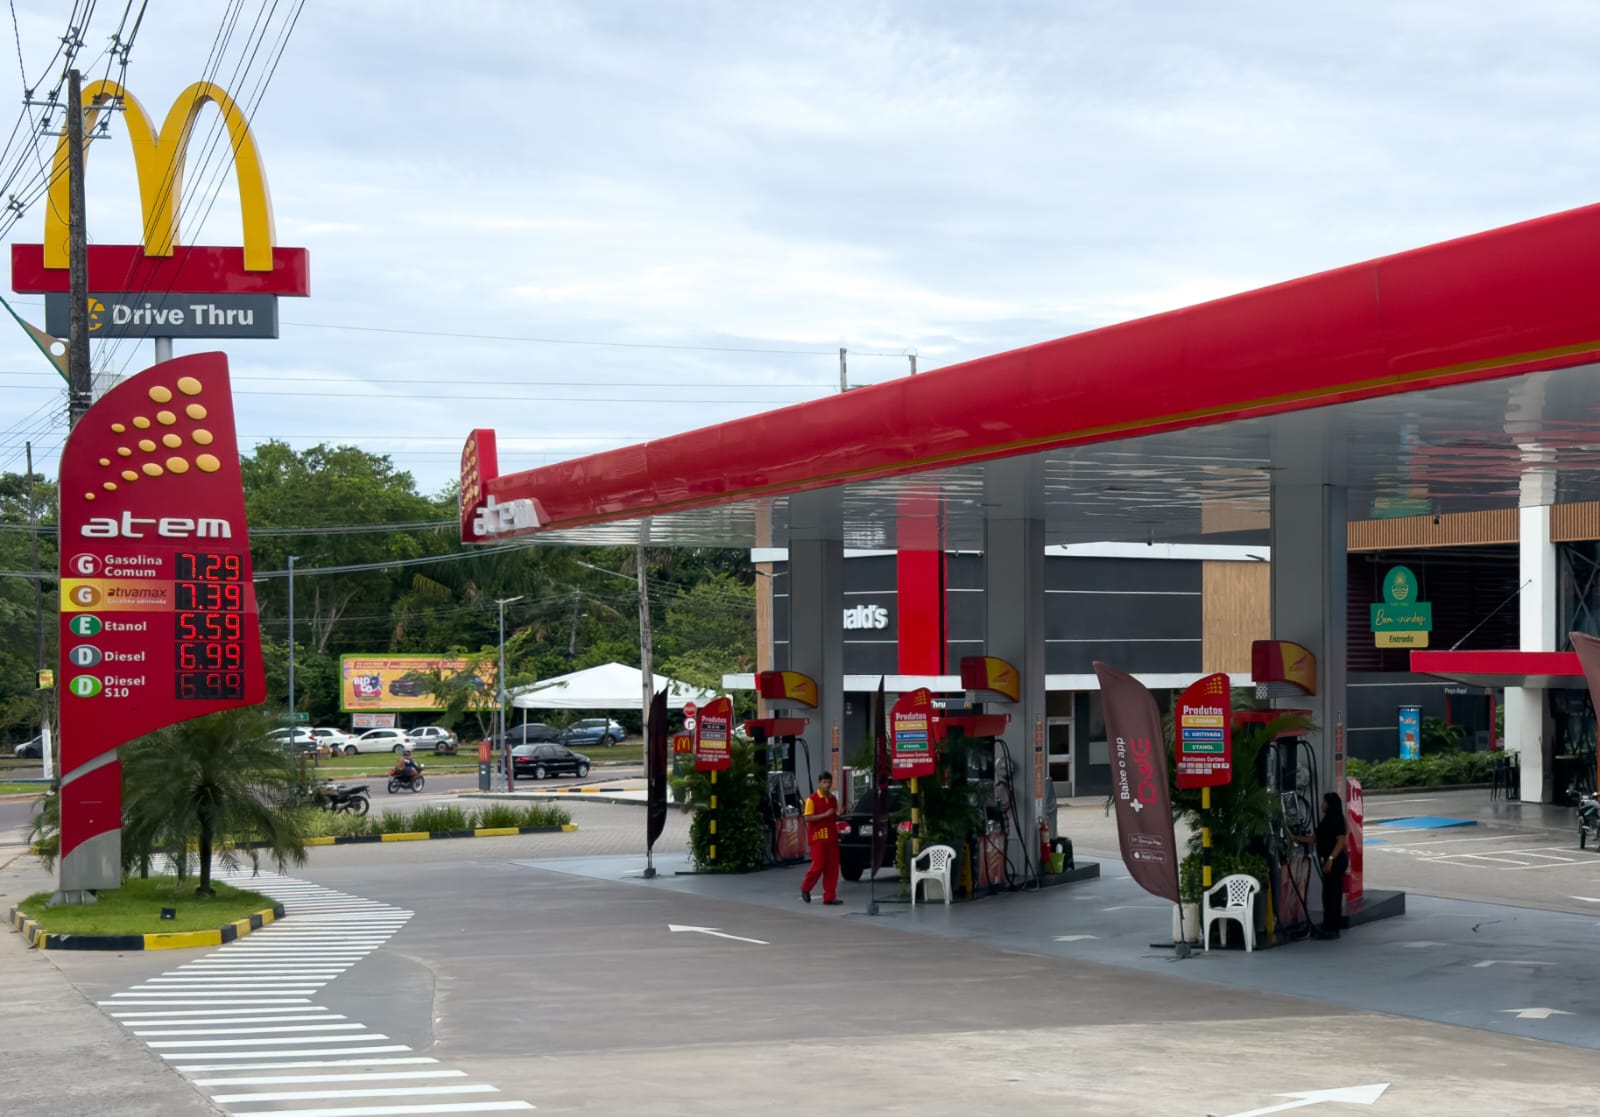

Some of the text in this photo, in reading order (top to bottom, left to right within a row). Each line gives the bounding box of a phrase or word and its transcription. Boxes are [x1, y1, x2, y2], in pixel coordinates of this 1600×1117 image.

[112, 303, 254, 325] Drive Thru
[81, 510, 232, 538] atem
[78, 555, 93, 574] G
[105, 555, 163, 566] Gasolina
[183, 553, 240, 580] 7.29
[105, 566, 156, 577] Comum
[78, 588, 93, 604] G
[107, 586, 167, 599] ativamax
[182, 583, 240, 610] 7.39
[80, 617, 92, 634] E
[105, 621, 147, 631] Etanol
[180, 614, 240, 639] 5.59
[78, 647, 93, 665] D
[105, 651, 145, 662] Diesel
[181, 643, 240, 669] 6.99
[78, 677, 93, 695] D
[105, 675, 145, 686] Diesel
[105, 688, 129, 698] S10
[895, 712, 927, 721] Produtos
[1183, 705, 1223, 715] Produtos
[1115, 737, 1126, 758] app
[1120, 770, 1130, 800] Baixe
